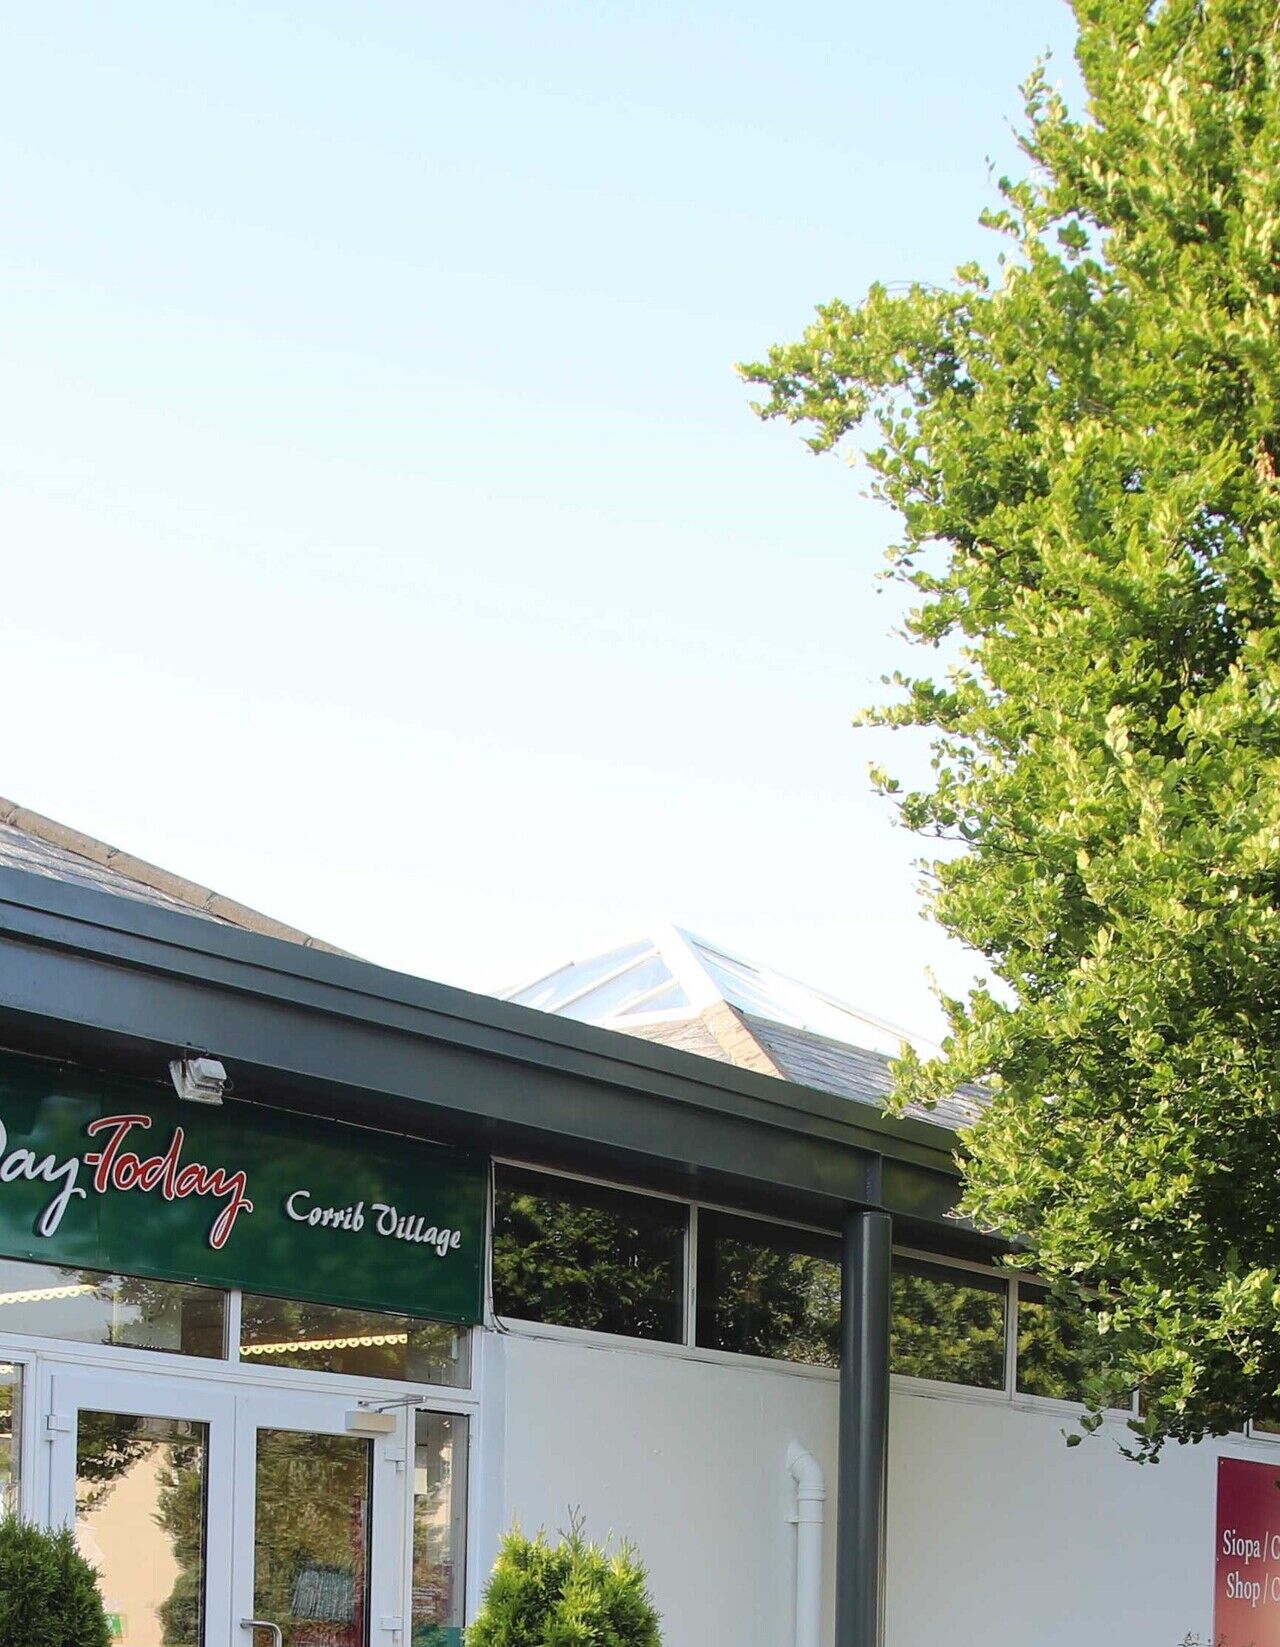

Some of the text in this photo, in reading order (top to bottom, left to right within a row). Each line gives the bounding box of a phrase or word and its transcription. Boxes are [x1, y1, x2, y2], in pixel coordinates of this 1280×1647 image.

[285, 1190, 462, 1257] Corrib Village
[1223, 1529, 1261, 1564] Siopa
[1226, 1571, 1261, 1608] Shop
